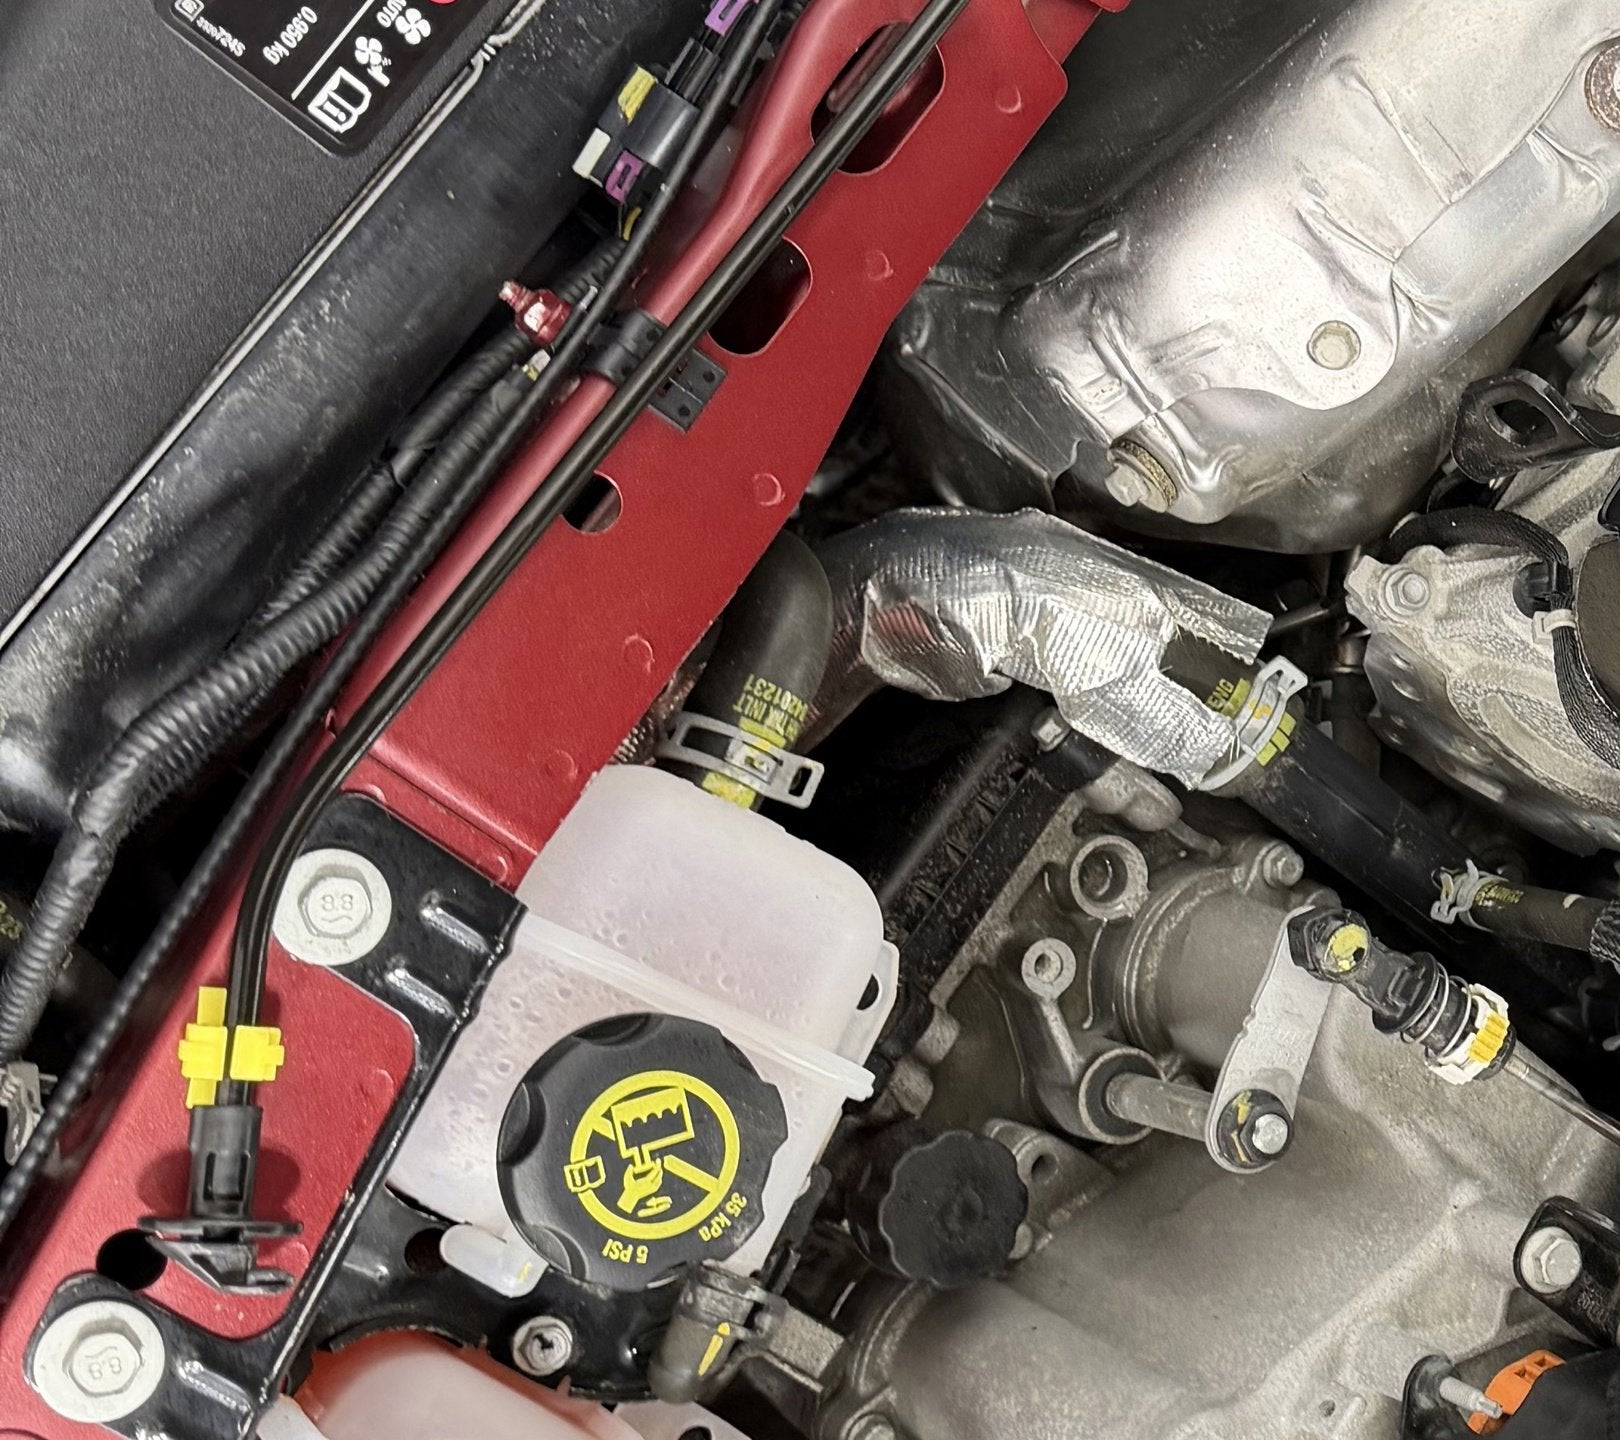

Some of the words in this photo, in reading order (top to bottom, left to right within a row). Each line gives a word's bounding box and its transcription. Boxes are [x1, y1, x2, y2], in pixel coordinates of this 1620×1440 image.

[262, 41, 290, 65] kg
[733, 693, 767, 722] INLT
[725, 1192, 747, 1218] 35
[698, 1212, 732, 1242] kPa
[602, 1238, 634, 1263] PSI
[636, 1245, 649, 1264] 5
